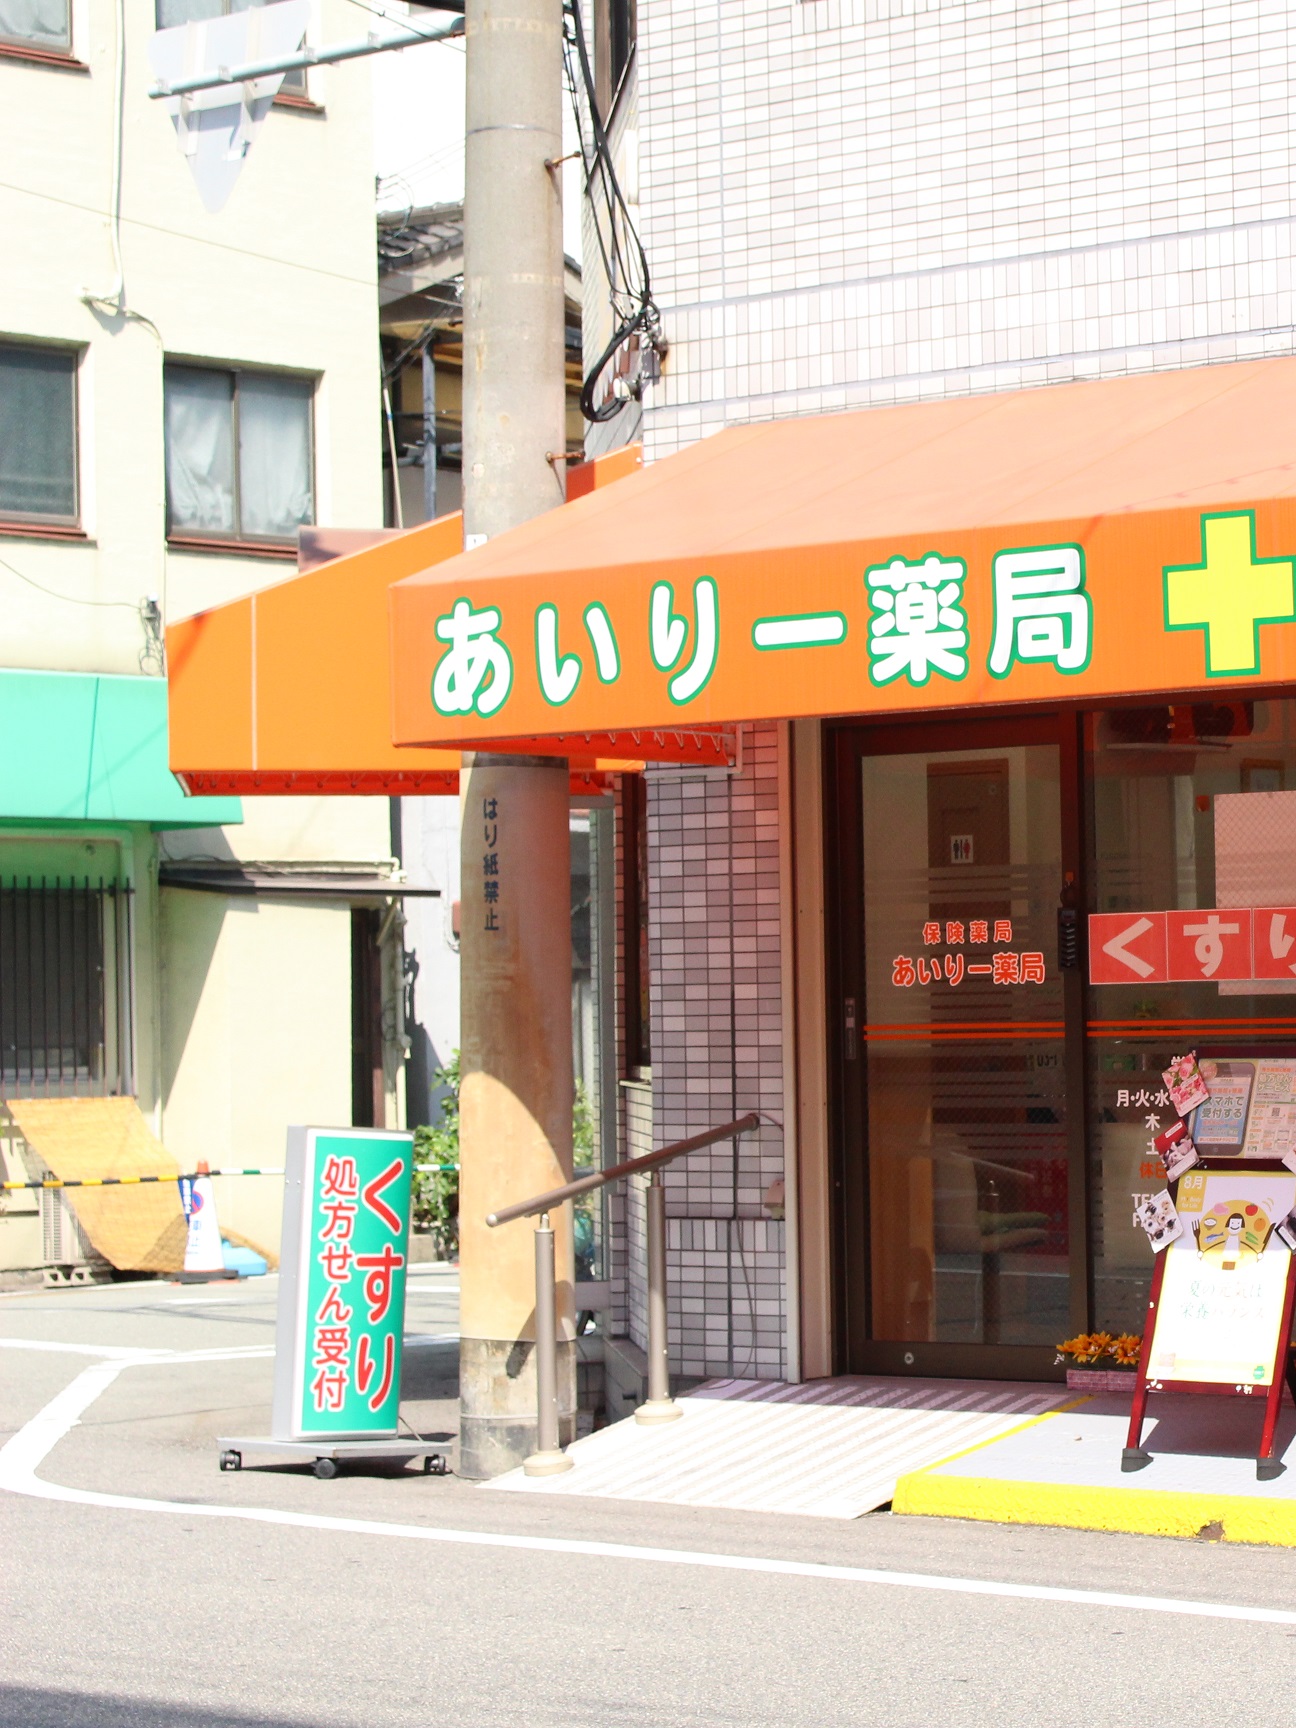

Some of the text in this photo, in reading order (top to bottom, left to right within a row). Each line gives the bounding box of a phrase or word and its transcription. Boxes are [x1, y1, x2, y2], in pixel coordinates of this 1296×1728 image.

[431, 543, 1095, 719] あいりー薬局
[483, 797, 499, 931] はり紙禁止
[892, 952, 1046, 987] あいりー薬局
[923, 919, 1012, 944] 保険薬局
[1145, 1113, 1160, 1131] 木
[1184, 1175, 1203, 1189] 8月
[311, 1154, 359, 1412] 処方せん受付
[354, 1158, 405, 1413] くすり
